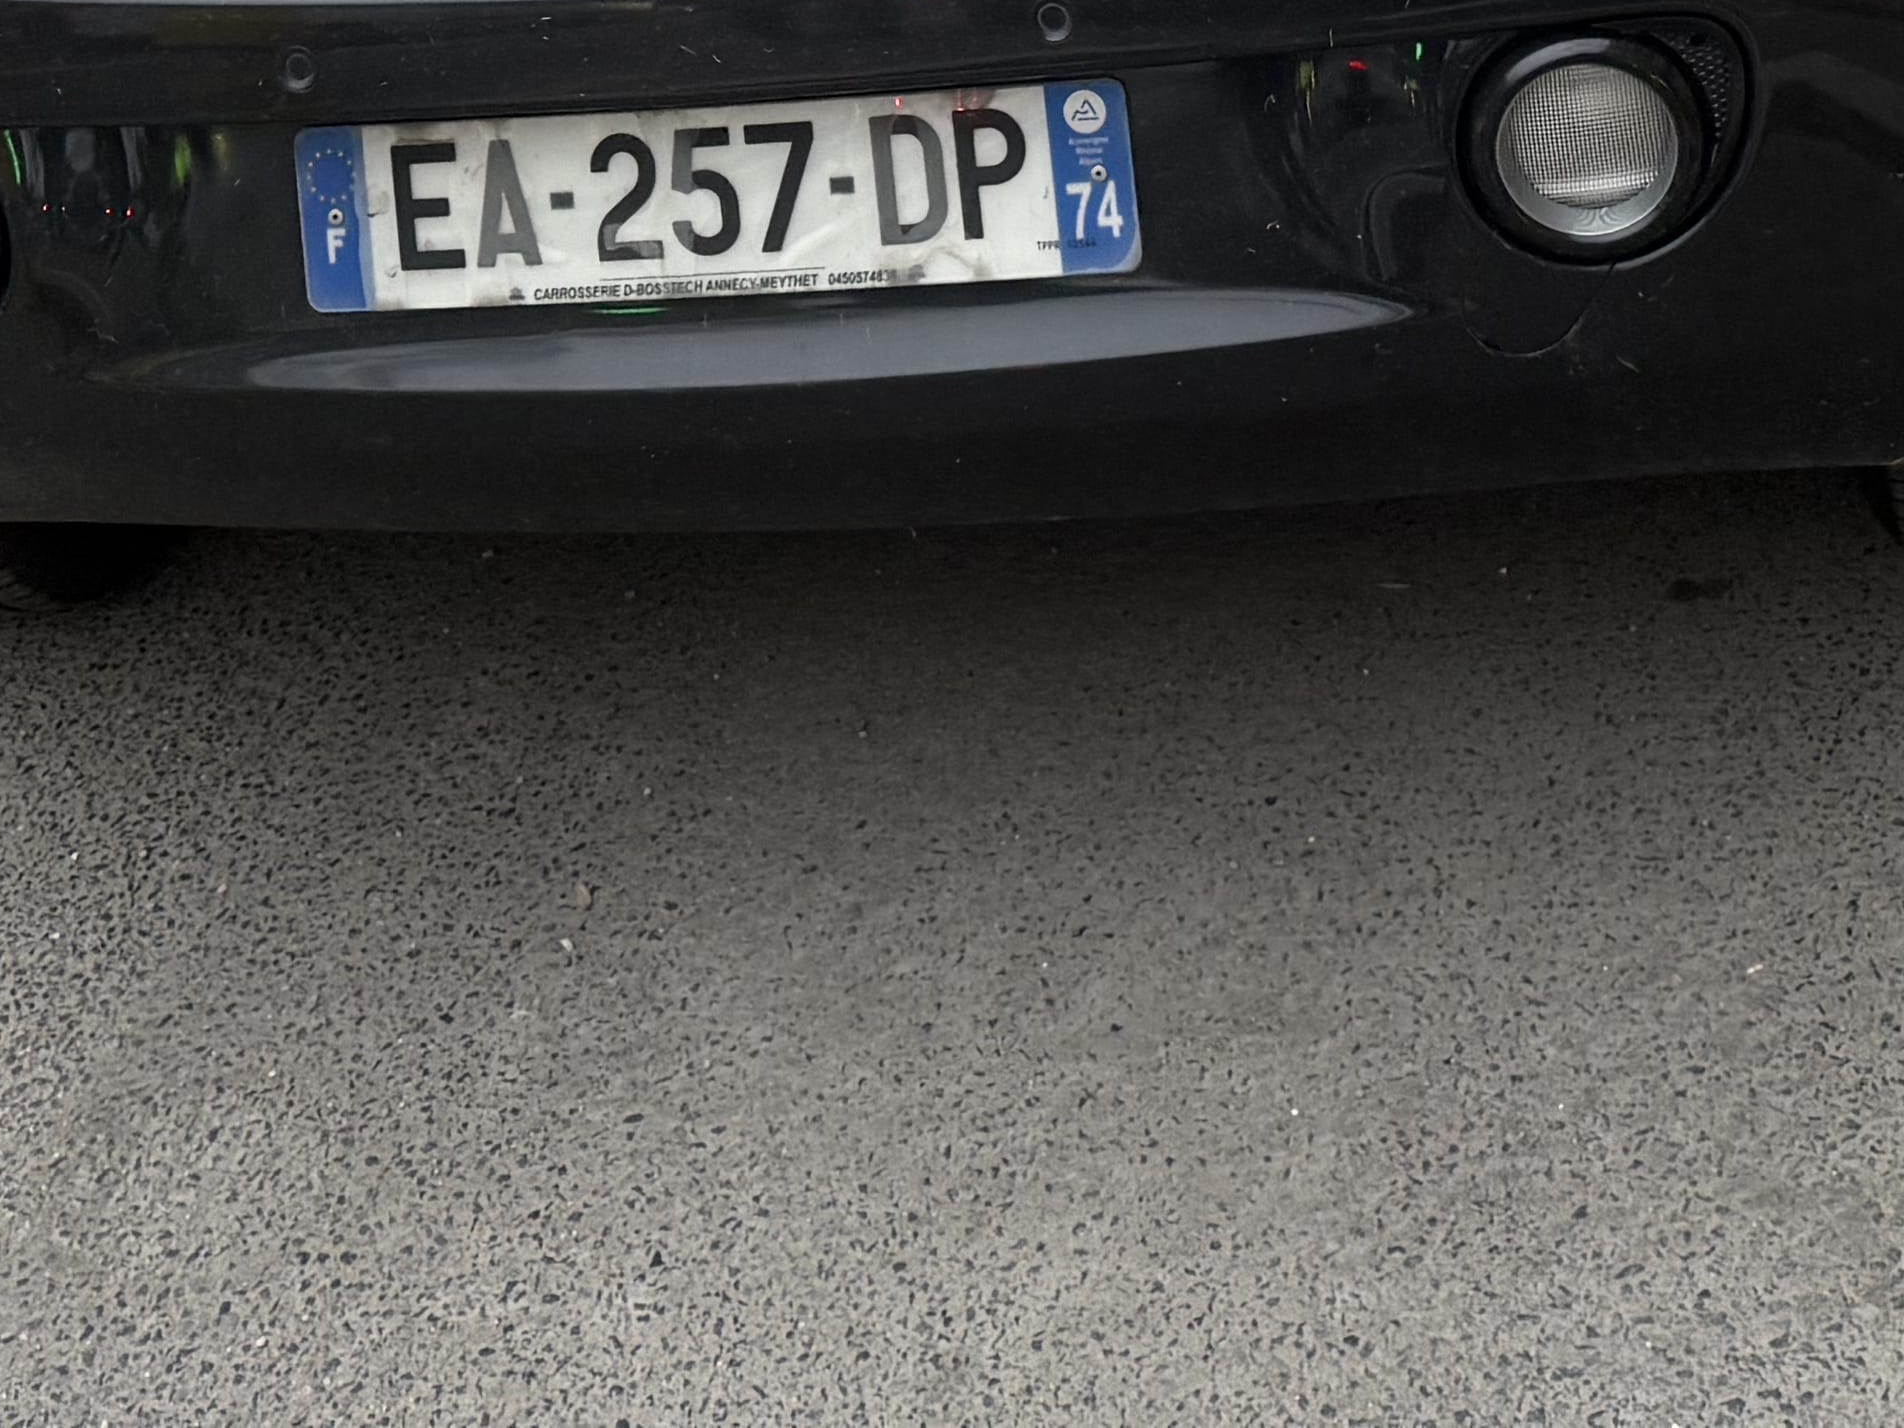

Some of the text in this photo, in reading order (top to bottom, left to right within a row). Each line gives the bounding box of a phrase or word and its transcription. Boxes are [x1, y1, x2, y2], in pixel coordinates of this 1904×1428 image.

[390, 108, 1027, 272] EA-257-DP
[1065, 179, 1125, 241] 74
[326, 227, 347, 265] F
[534, 283, 622, 302] CARROSSERIE
[705, 273, 819, 293] ANNECY-MEYTHET
